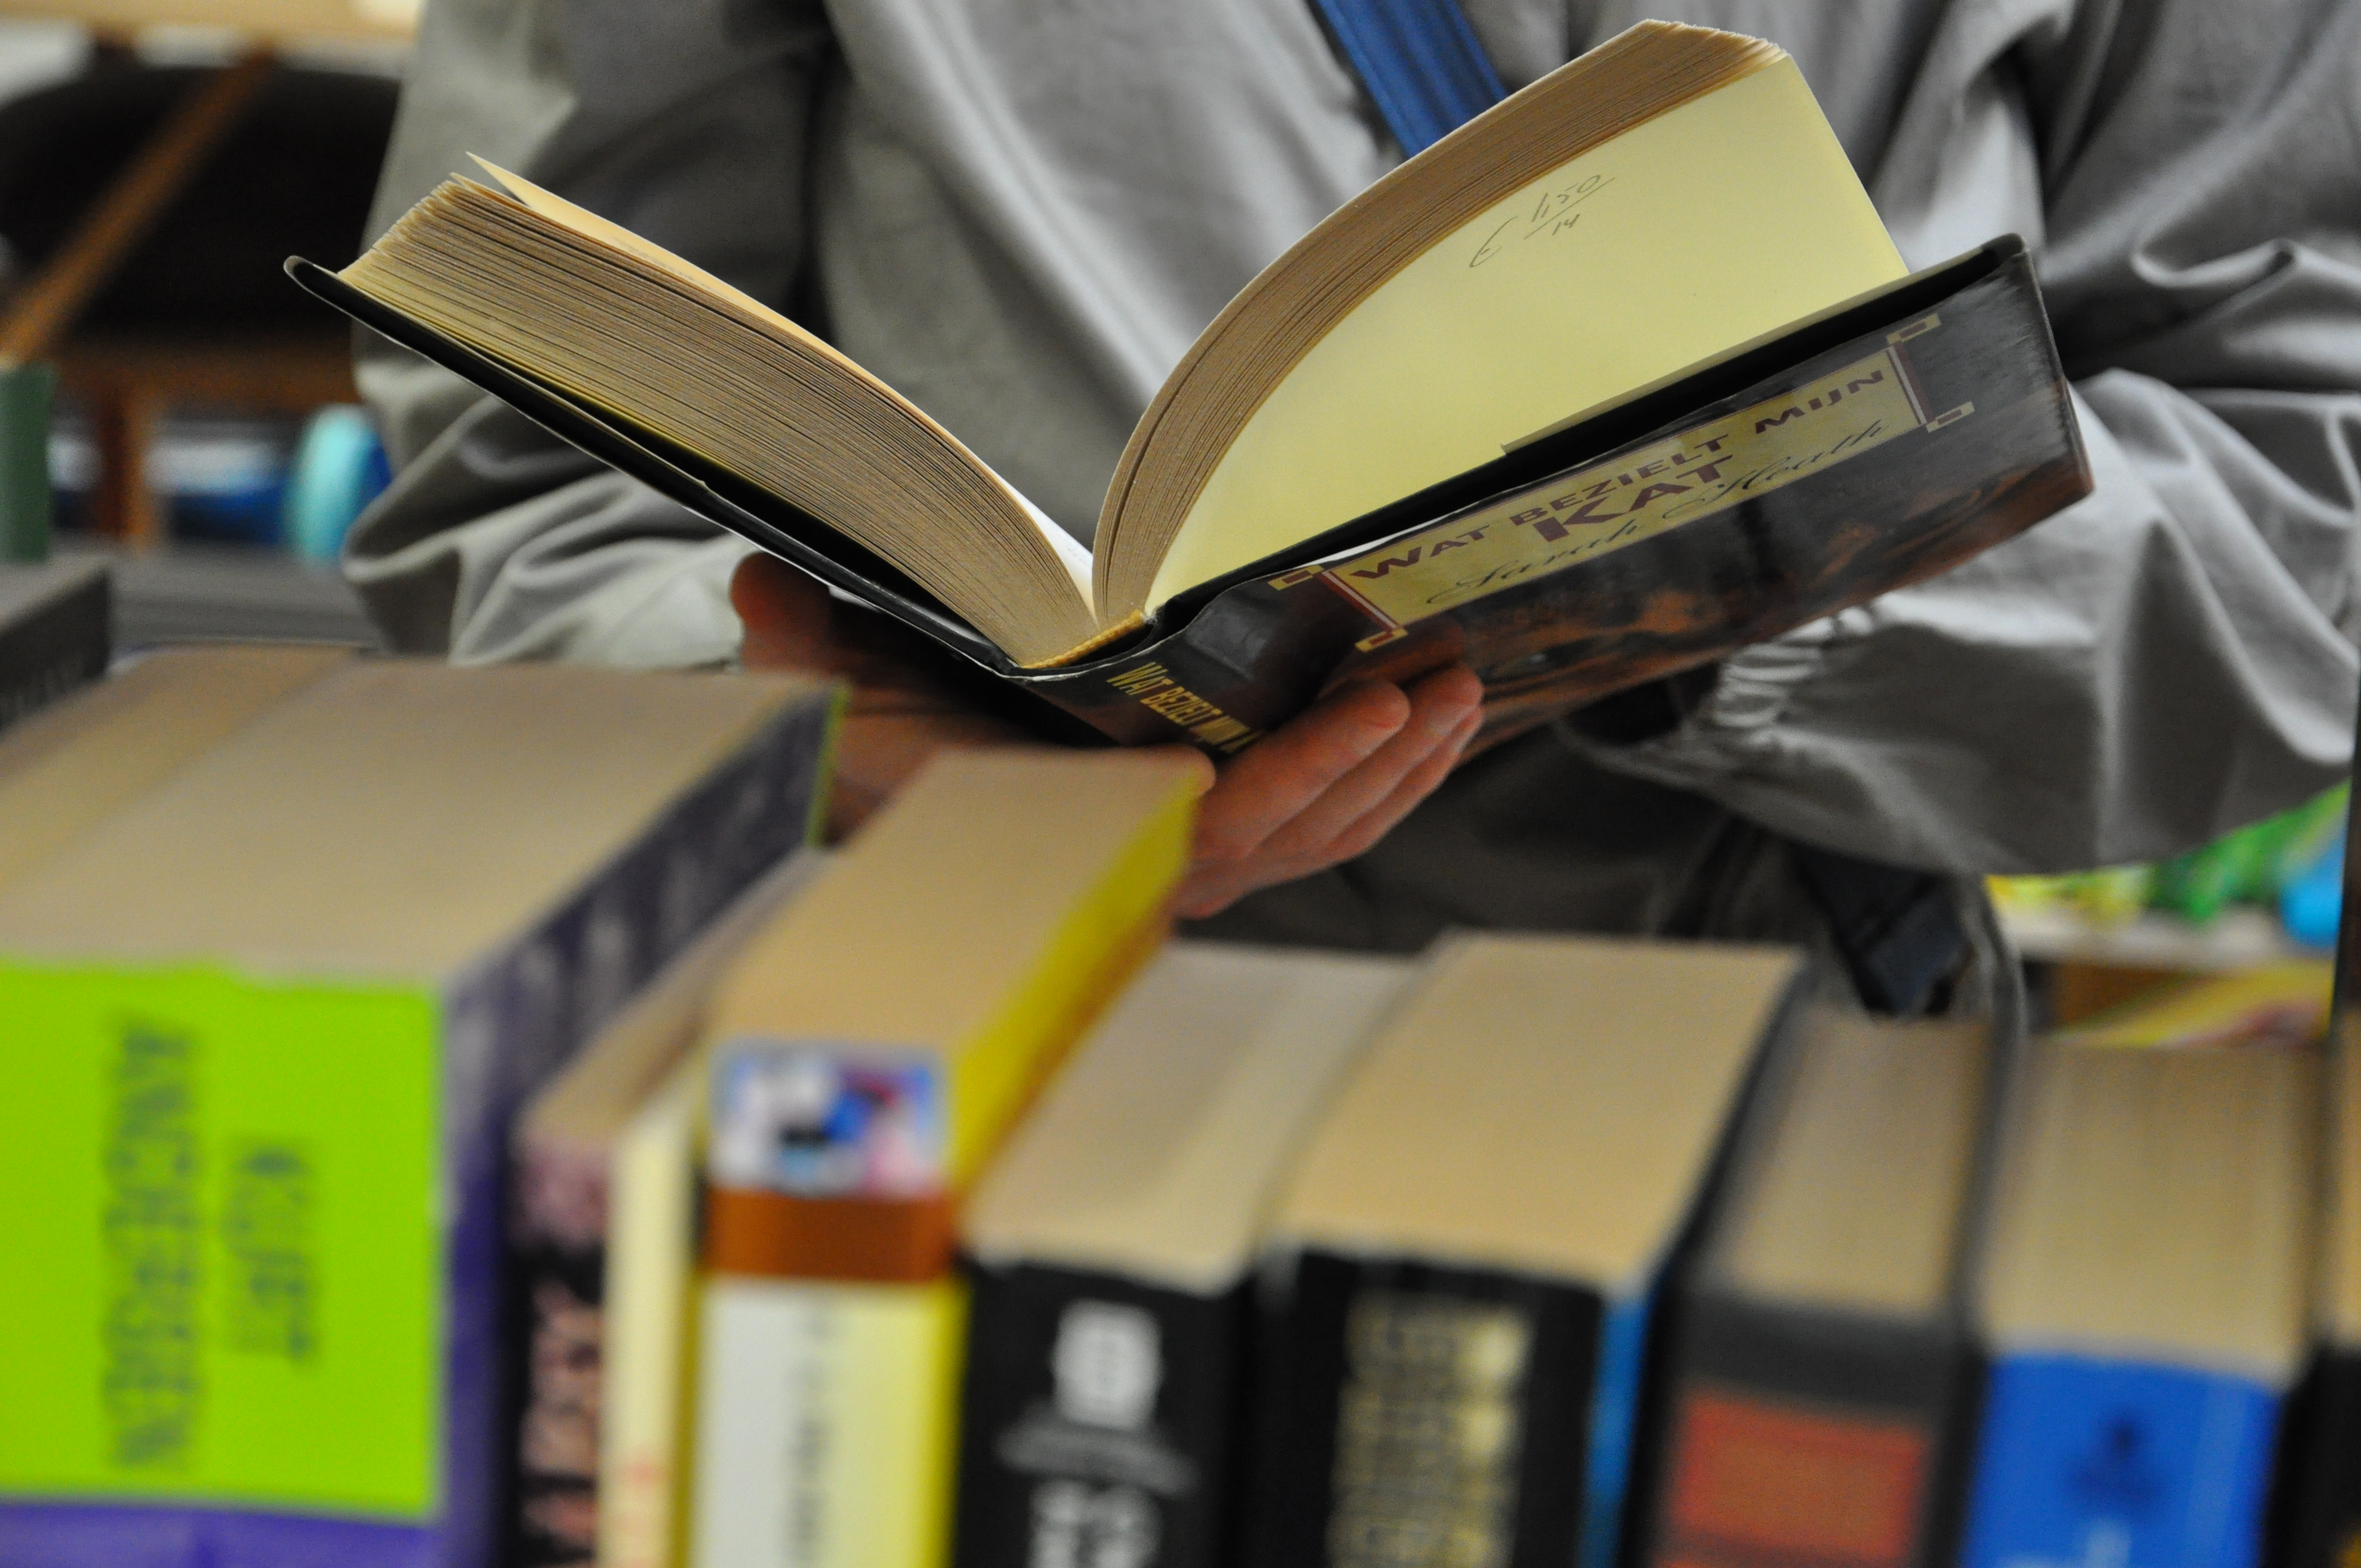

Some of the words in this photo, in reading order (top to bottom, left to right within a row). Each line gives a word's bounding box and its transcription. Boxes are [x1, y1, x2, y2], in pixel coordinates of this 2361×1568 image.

[1349, 524, 1435, 579] WAT
[1509, 433, 1728, 526] BEZIELT
[1755, 370, 1884, 434] MIJN
[1425, 518, 1640, 604] Sarah
[1662, 419, 1890, 519] Heath
[1532, 454, 1733, 542] KAT
[1106, 662, 1174, 696] WAT
